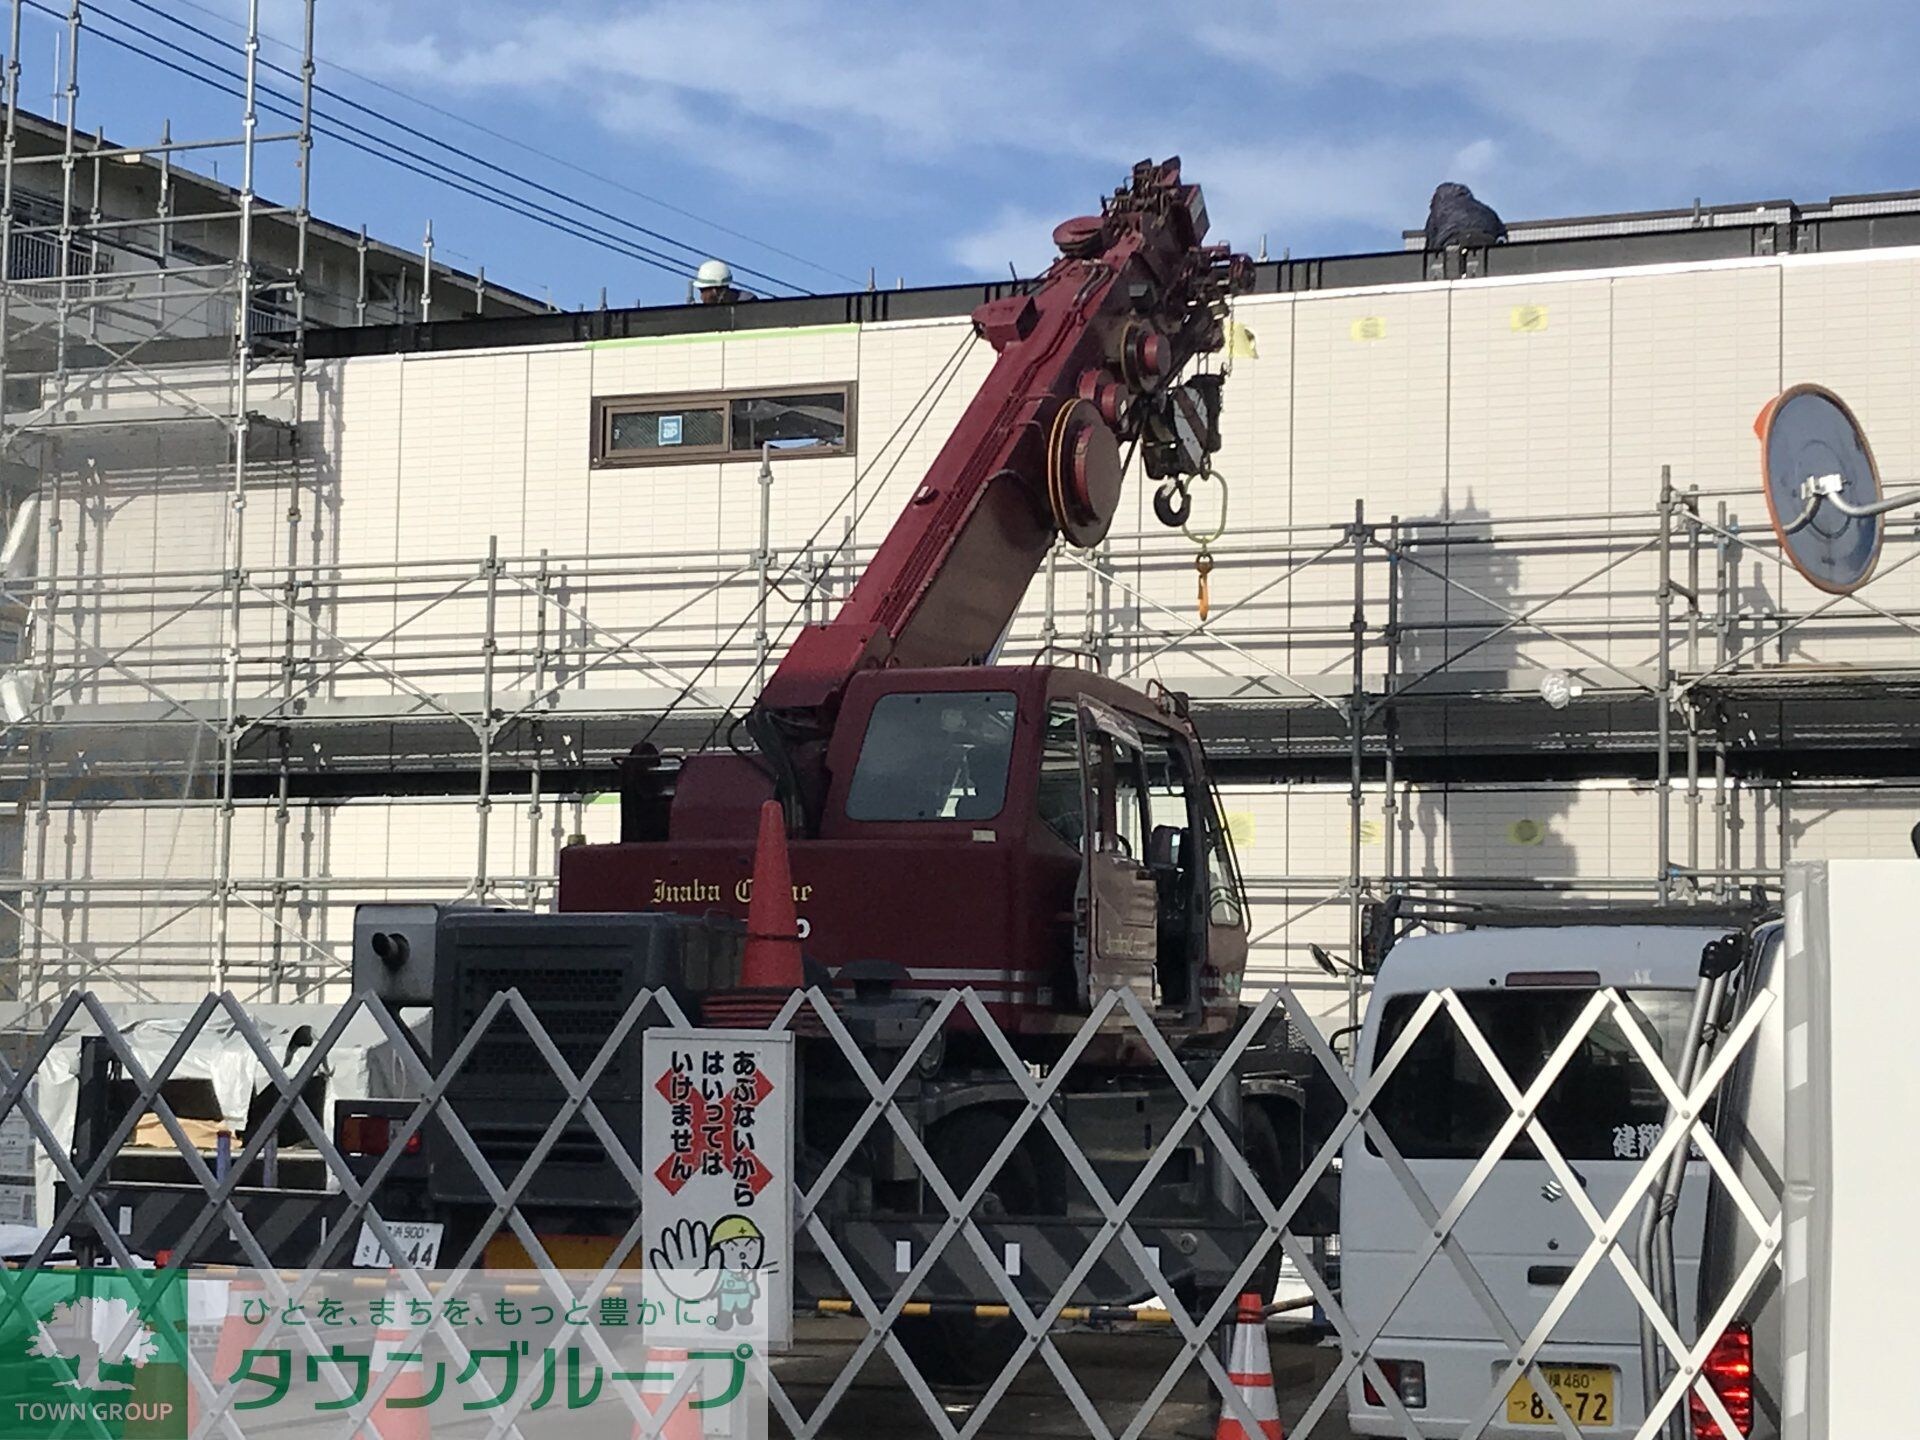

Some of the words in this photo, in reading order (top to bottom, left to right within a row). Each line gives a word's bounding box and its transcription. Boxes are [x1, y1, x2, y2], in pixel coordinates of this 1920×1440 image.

[651, 879, 720, 903] Inaba
[670, 1050, 694, 1181] いけません
[702, 1050, 725, 1176] はいっては
[732, 1050, 756, 1208] あぶないから
